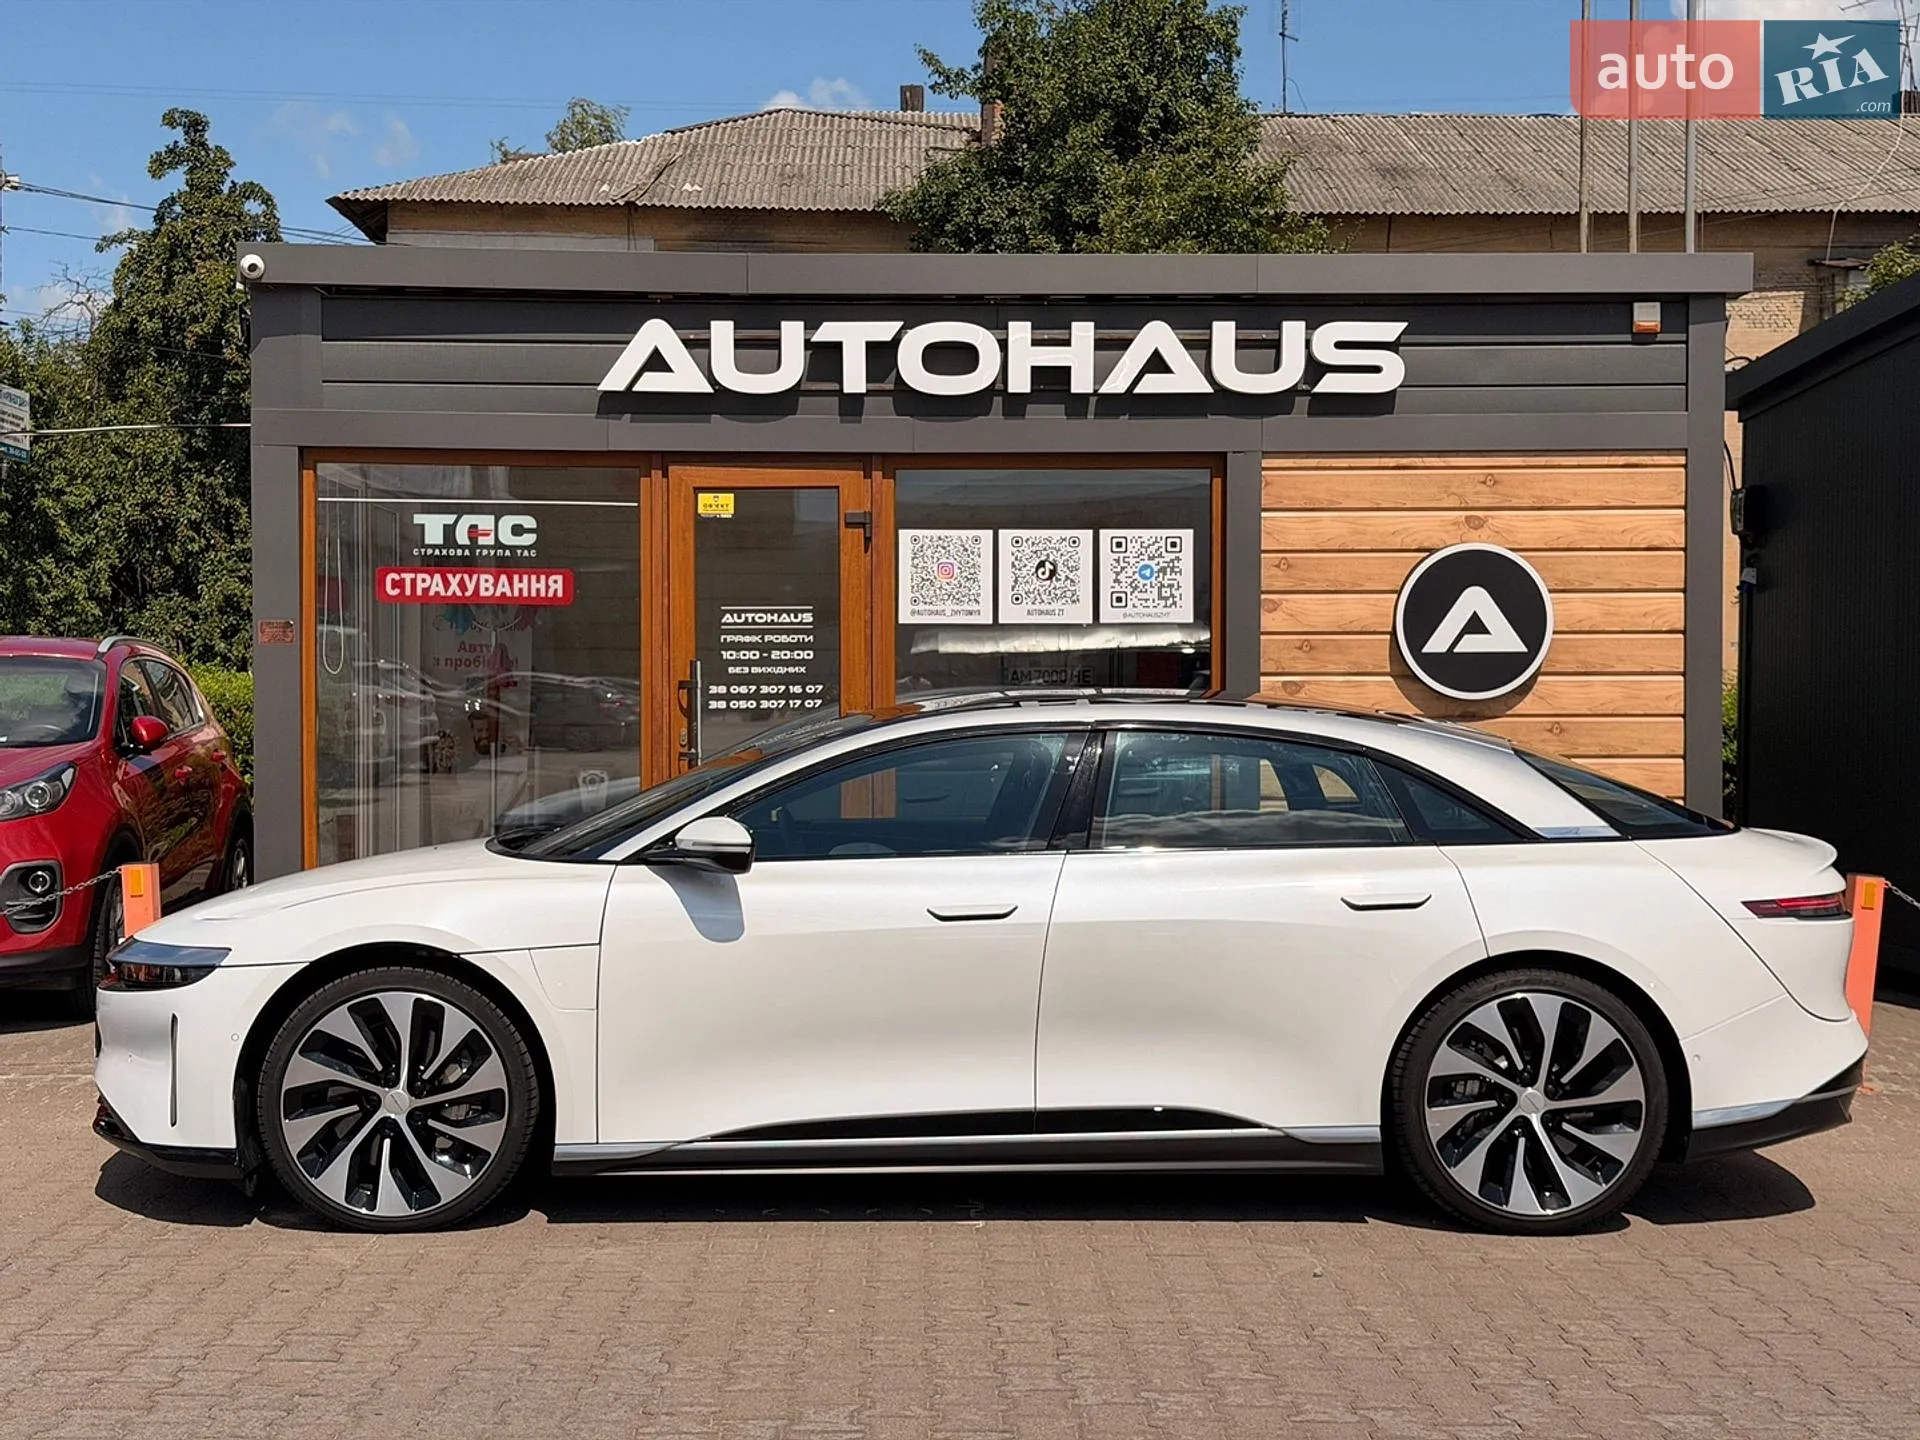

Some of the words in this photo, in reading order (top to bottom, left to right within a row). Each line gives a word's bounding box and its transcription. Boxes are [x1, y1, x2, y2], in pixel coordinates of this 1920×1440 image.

[596, 318, 1409, 395] AUTOHAUS
[413, 548, 471, 557] СТРАХОВА
[475, 549, 512, 557] ГРУПА
[516, 549, 537, 557] ТАС
[385, 572, 564, 599] СТРАХУВАННЯ
[721, 612, 814, 623] AUTOHAUS
[763, 635, 814, 643] РОБОТИ
[721, 650, 760, 660] 10:00
[770, 650, 814, 660] 20:00
[728, 666, 750, 674] БЕЗ
[750, 666, 807, 675] ВИХІДНИХ
[708, 685, 727, 694] 38
[729, 685, 757, 694] 067
[759, 685, 786, 694] 307
[788, 685, 803, 694] 16
[805, 685, 824, 694] 07
[729, 700, 757, 709] 050
[759, 700, 786, 709] 307
[788, 700, 802, 708] 17
[804, 700, 823, 708] 07
